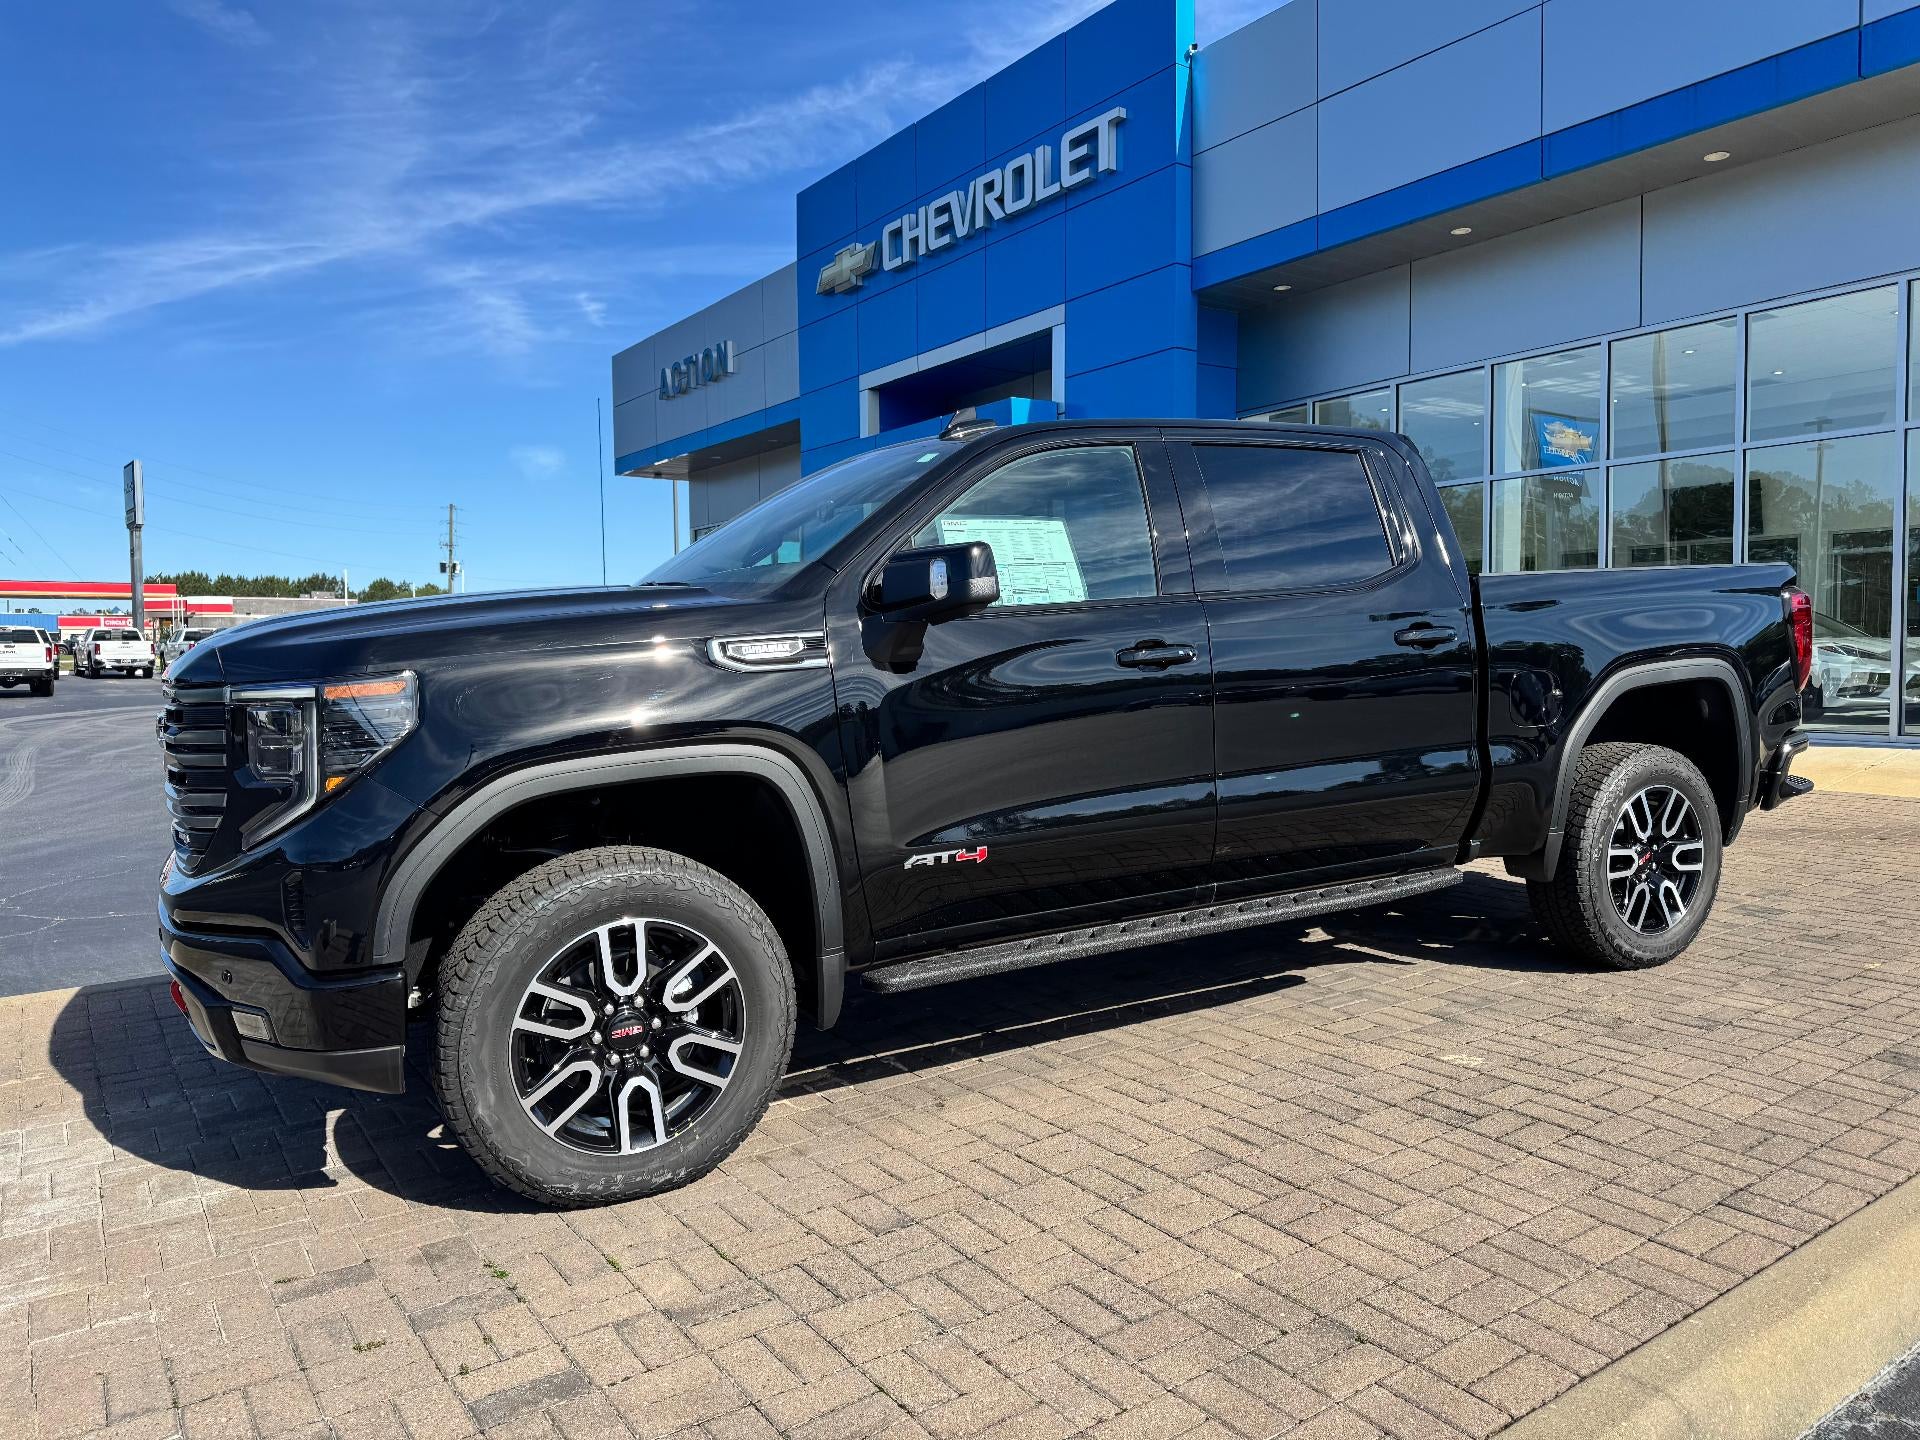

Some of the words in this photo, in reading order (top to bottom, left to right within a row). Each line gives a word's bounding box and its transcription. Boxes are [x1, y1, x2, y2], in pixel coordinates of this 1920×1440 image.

[881, 106, 1127, 272] CHEVROLET
[659, 340, 734, 400] ACTION
[741, 642, 791, 655] DURAMAX
[903, 845, 988, 870] AT4
[611, 1025, 643, 1039] GMC
